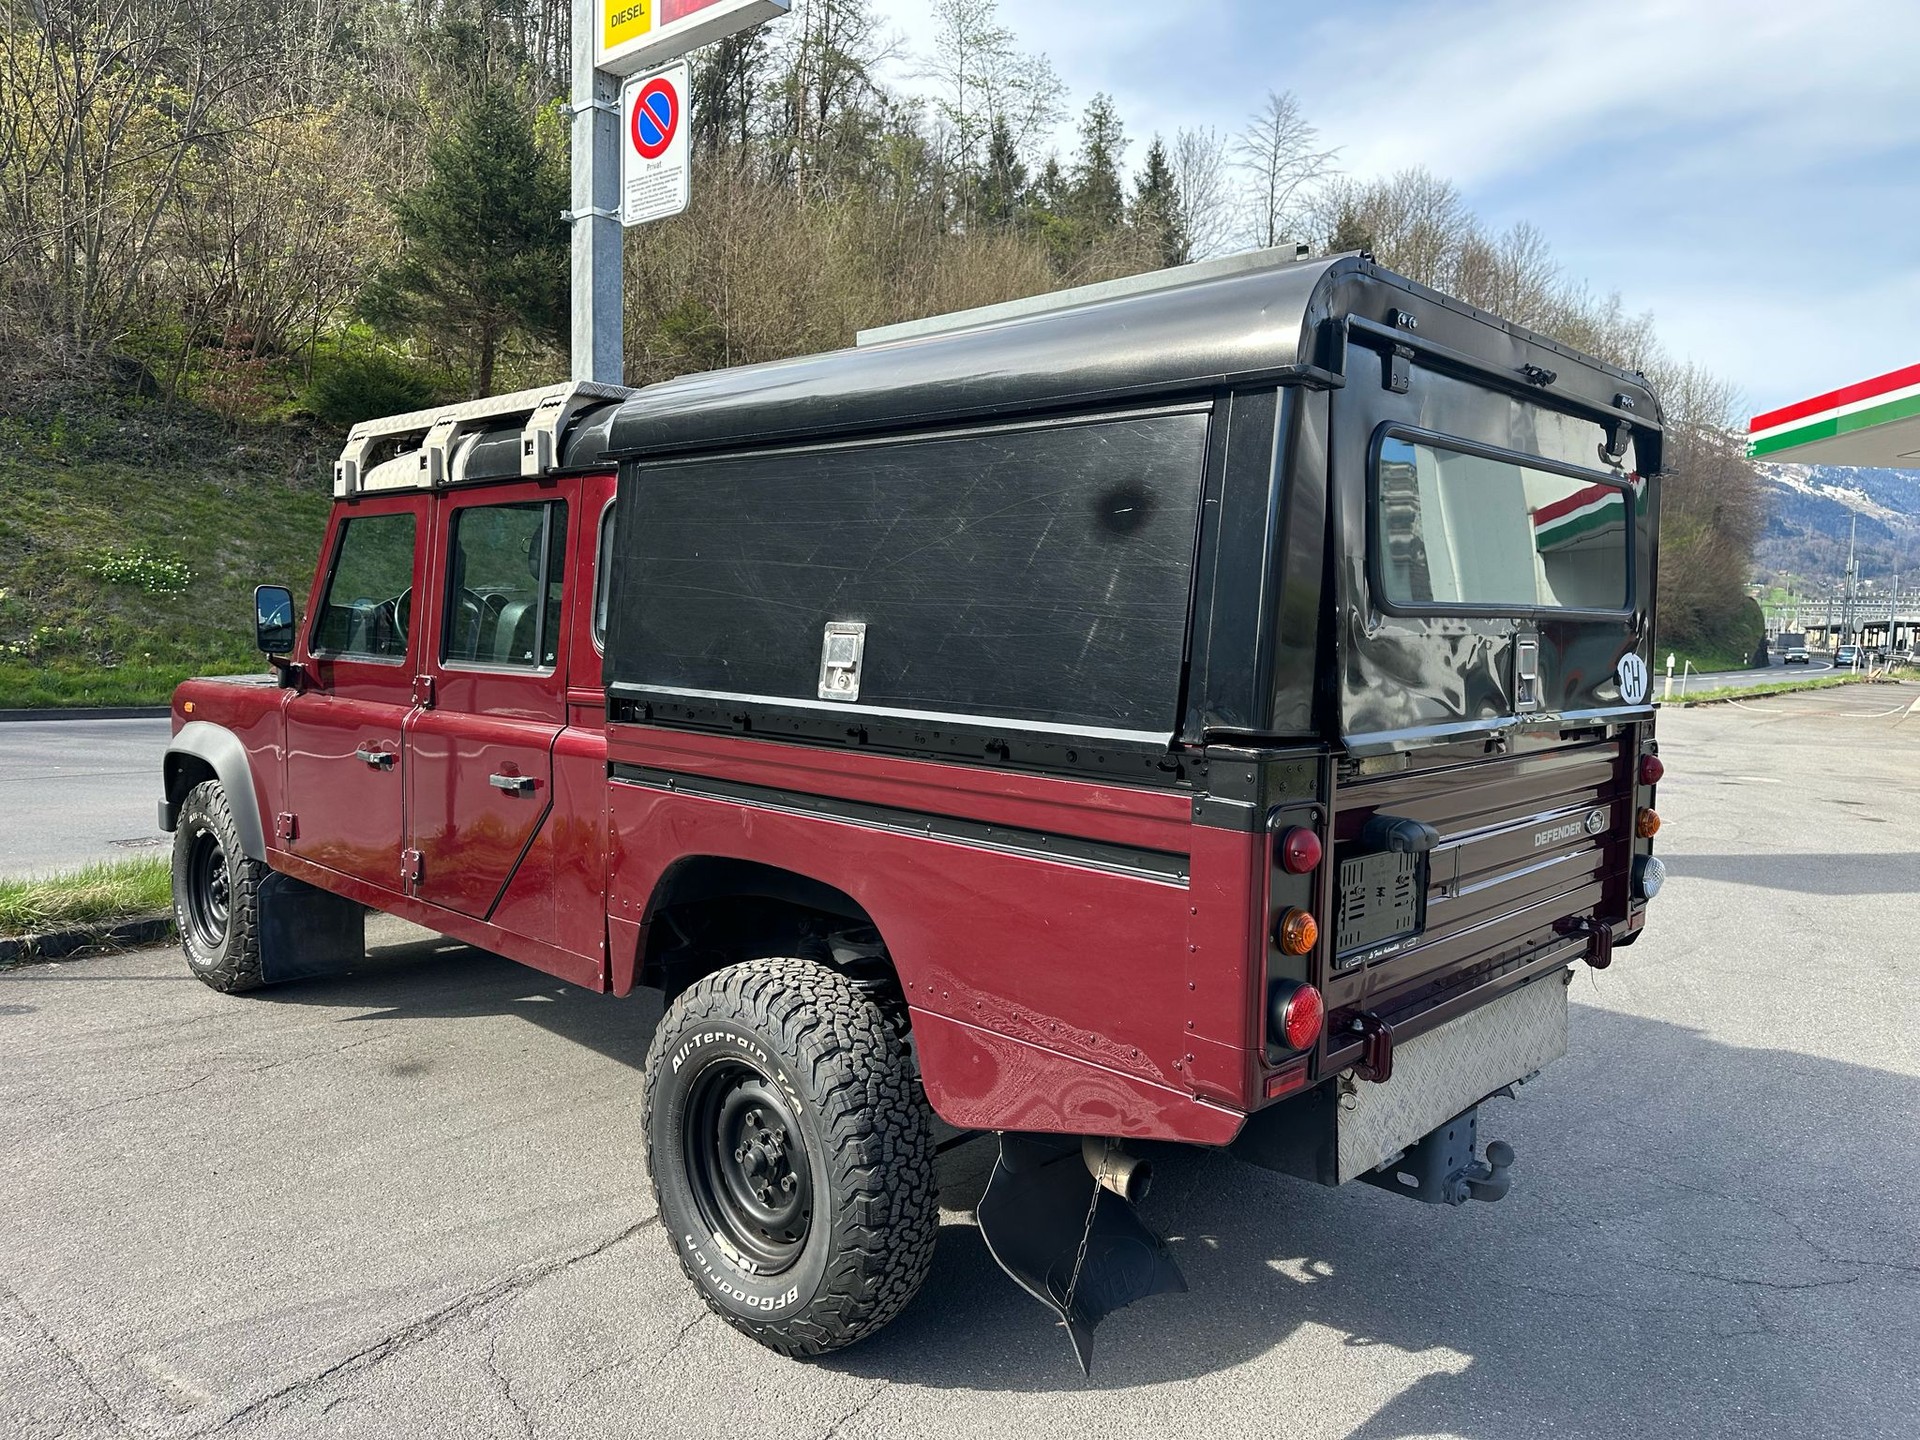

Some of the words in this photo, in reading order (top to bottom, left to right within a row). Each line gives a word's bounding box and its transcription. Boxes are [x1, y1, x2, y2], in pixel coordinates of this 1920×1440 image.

[611, 3, 645, 28] DIESEL
[1623, 660, 1641, 698] CH
[1534, 821, 1582, 847] DEFENDER
[671, 1031, 769, 1075] All-Terrain
